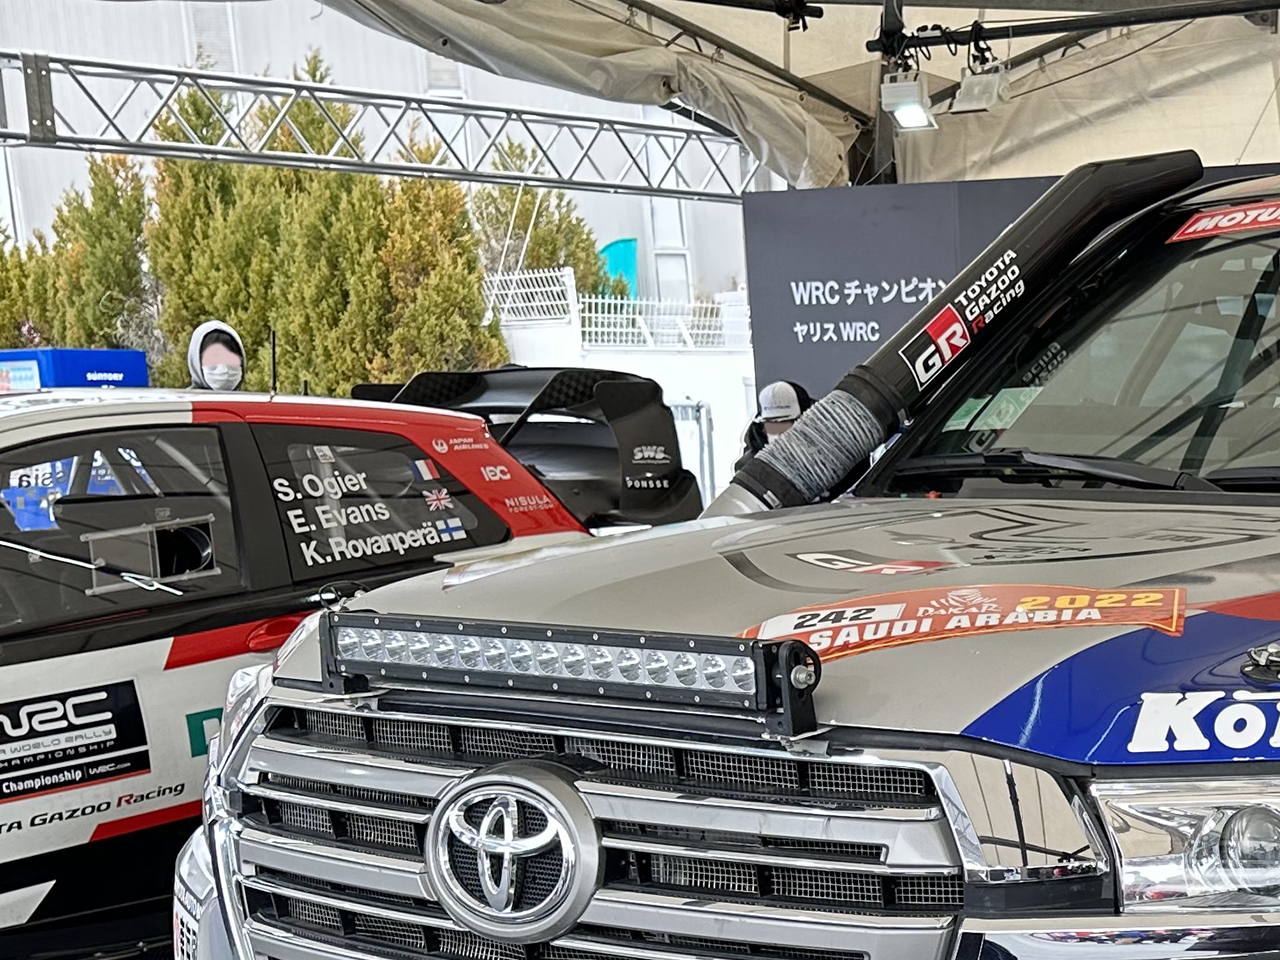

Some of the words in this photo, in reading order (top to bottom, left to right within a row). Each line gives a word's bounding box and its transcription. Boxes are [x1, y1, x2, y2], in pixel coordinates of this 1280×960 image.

[955, 249, 1018, 307] TOYOTA
[790, 281, 840, 305] WRC
[965, 264, 1021, 322] GAZOO
[972, 279, 1026, 335] Racing
[793, 322, 838, 343] ヤリス
[842, 321, 880, 342] WRC
[914, 323, 968, 384] GR
[302, 470, 367, 500] Ogier
[626, 478, 669, 489] PONSSE
[505, 495, 550, 507] NISULA
[287, 508, 316, 534] E.
[315, 501, 390, 529] Evans
[915, 601, 1003, 618] DAKAR
[1018, 592, 1166, 611] 2022
[793, 607, 876, 631] 242
[808, 617, 931, 651] SAUDI
[944, 606, 1102, 631] ARABIA
[2, 768, 83, 794] Championship
[30, 801, 111, 828] GAZOO
[116, 782, 186, 809] Racing
